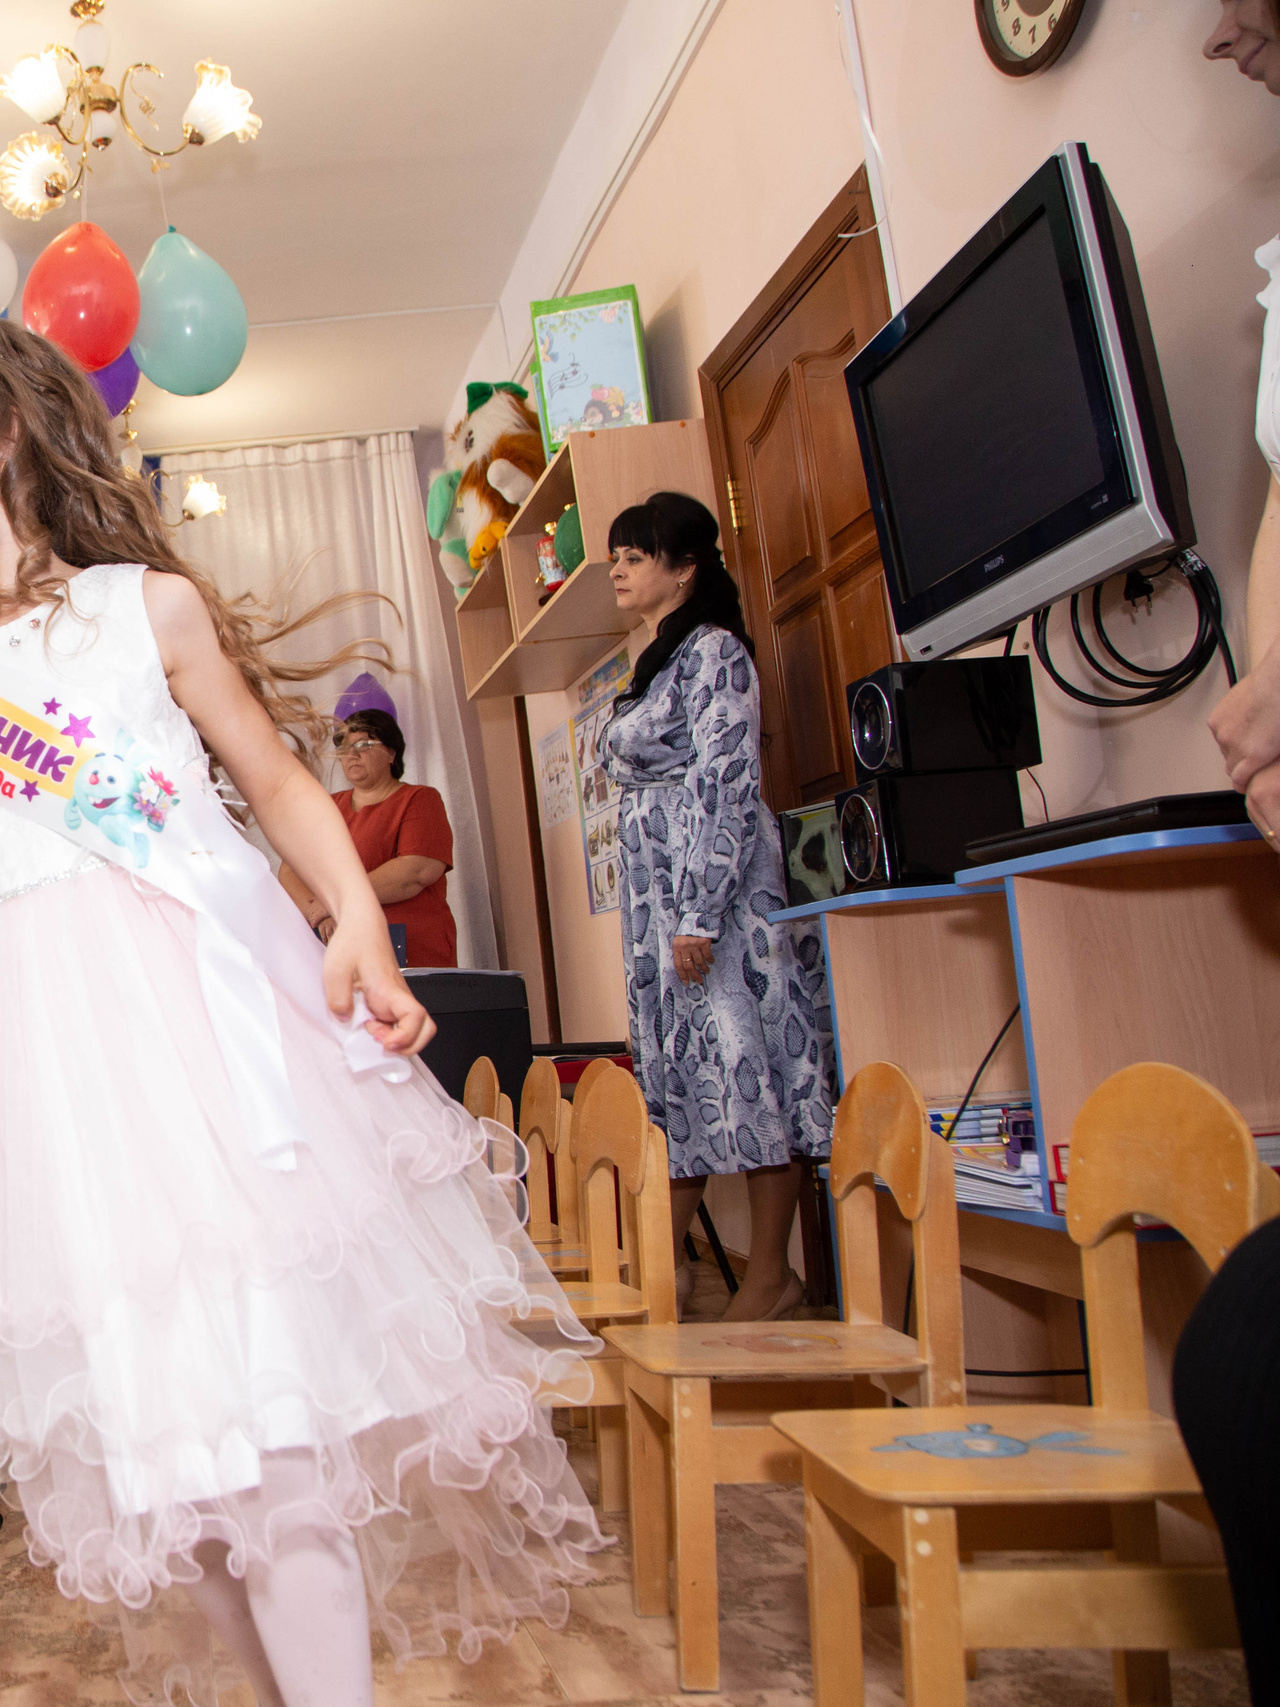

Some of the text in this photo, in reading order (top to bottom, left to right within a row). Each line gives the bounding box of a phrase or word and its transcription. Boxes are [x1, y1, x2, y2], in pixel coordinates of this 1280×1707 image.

[1012, 17, 1021, 37] 8
[1048, 13, 1057, 32] 6
[1028, 24, 1036, 45] 7
